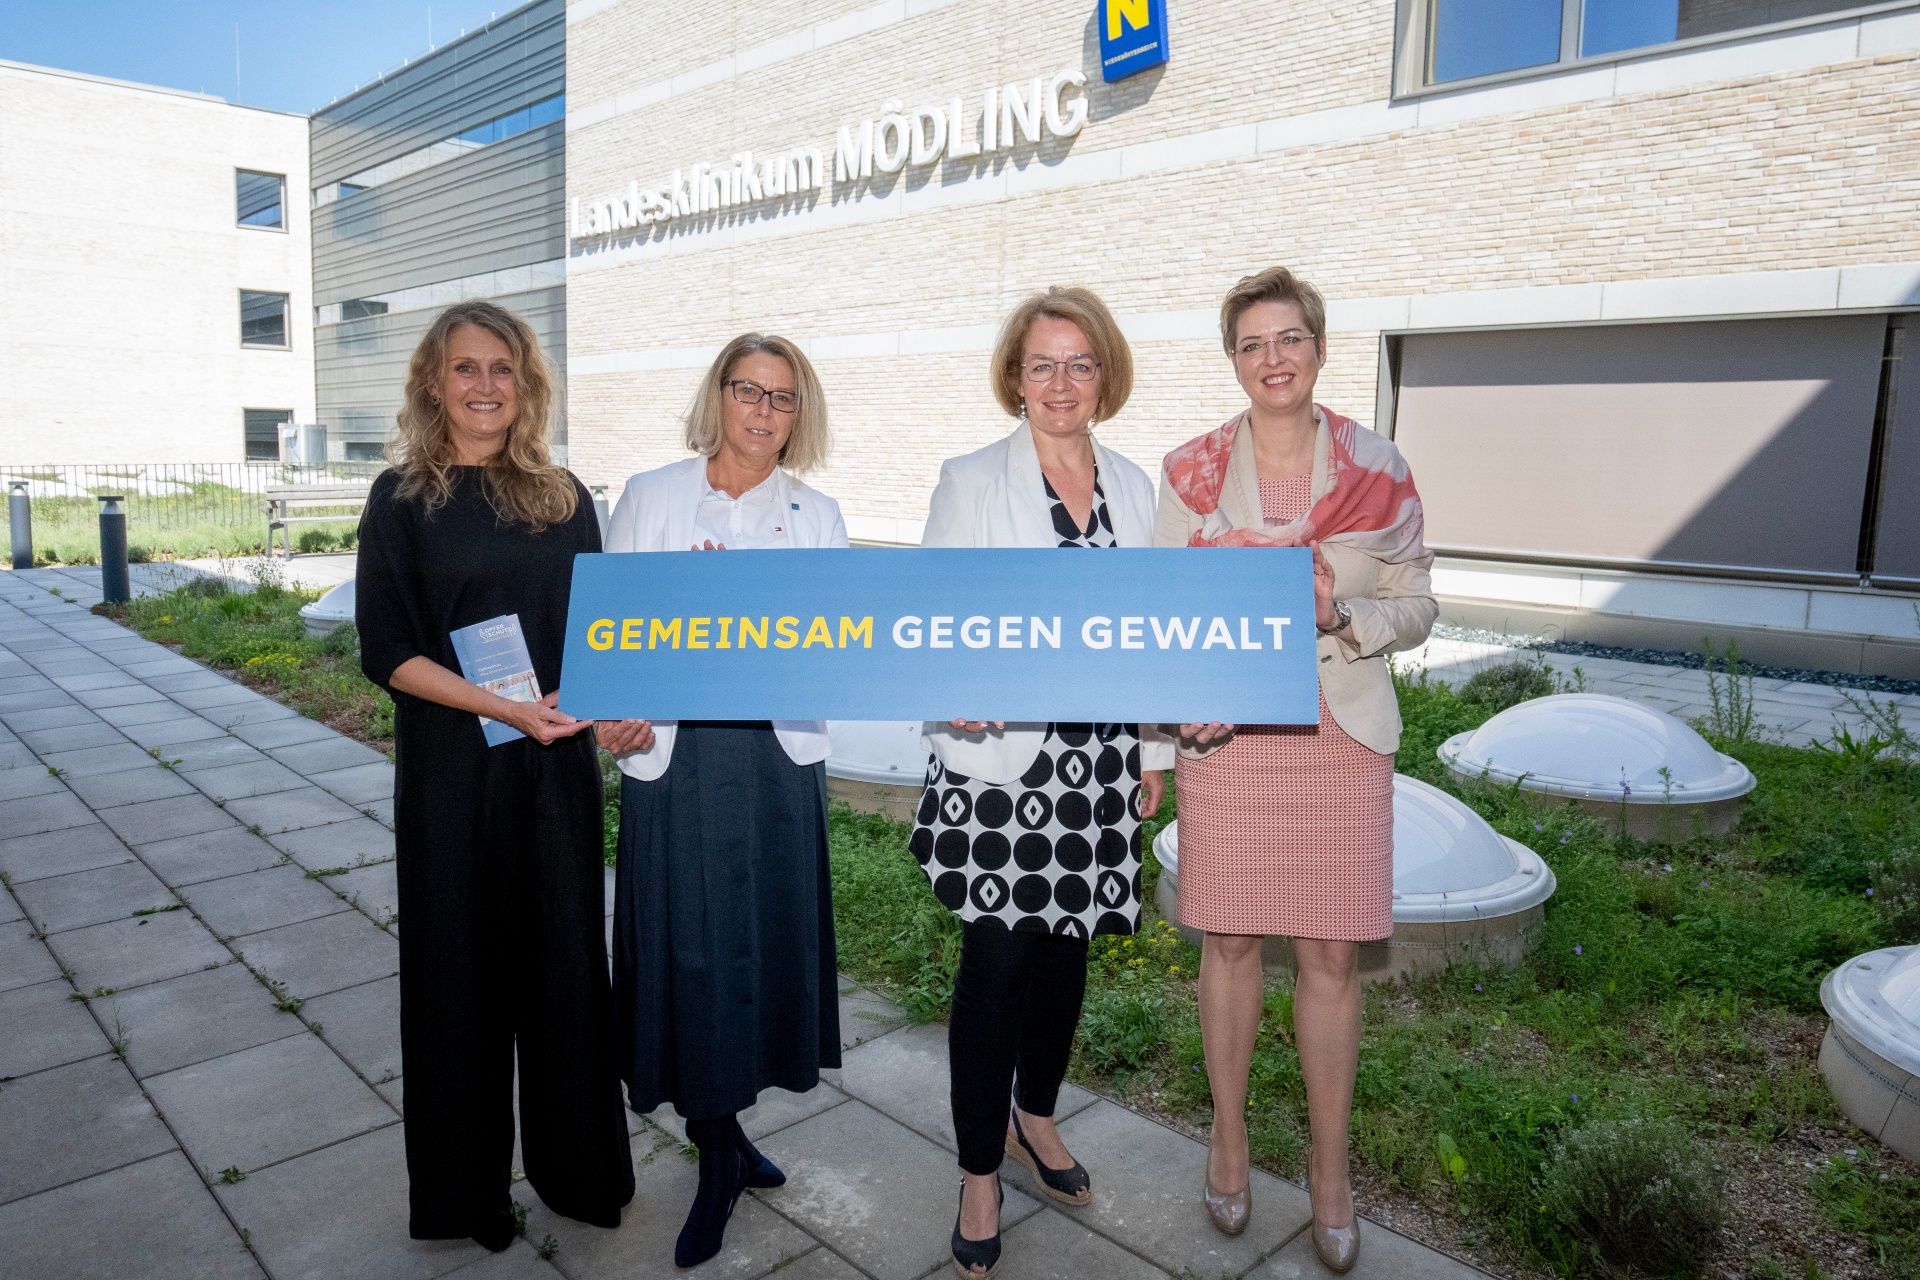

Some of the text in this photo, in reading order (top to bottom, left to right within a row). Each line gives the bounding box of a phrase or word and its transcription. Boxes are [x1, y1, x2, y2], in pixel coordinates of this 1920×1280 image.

[1107, 0, 1150, 41] N
[570, 68, 1089, 238] Landesklinikum MÖDLING
[587, 615, 1291, 651] GEMEINSAM GEGEN GEWALT
